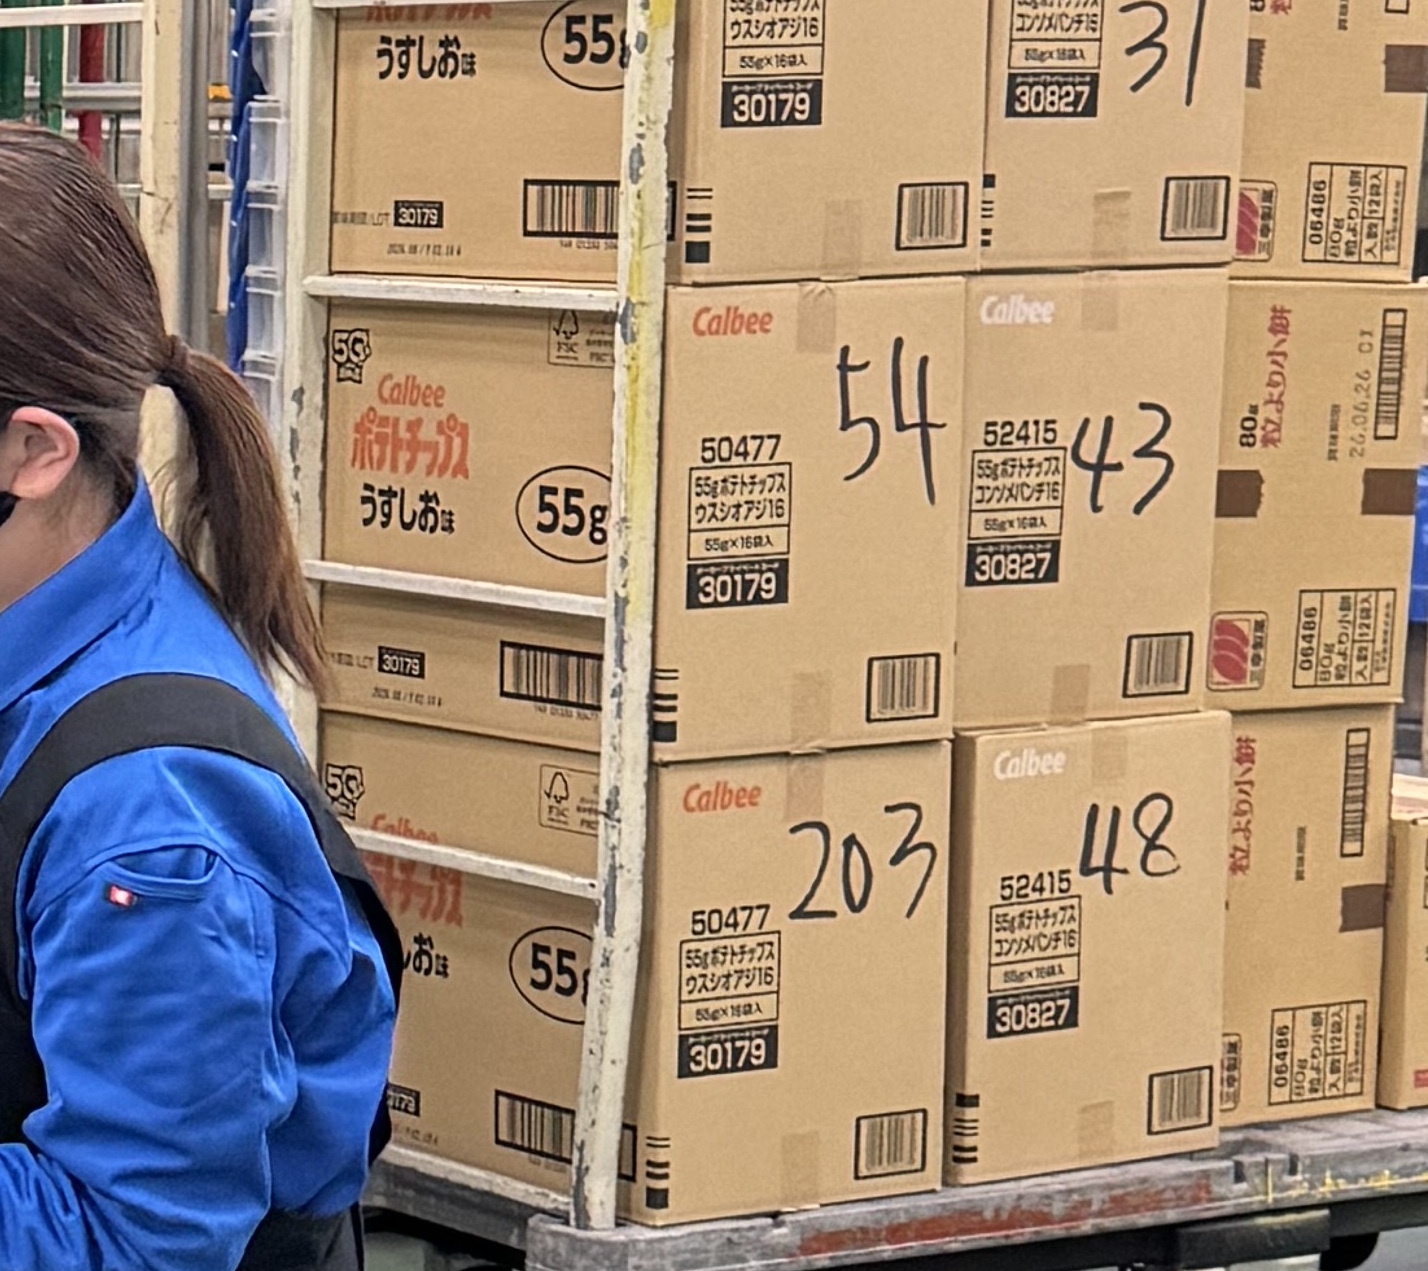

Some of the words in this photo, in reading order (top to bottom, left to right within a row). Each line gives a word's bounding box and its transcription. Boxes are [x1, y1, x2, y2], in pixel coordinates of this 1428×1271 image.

[730, 18, 819, 41] ウスシオアジ16
[376, 34, 477, 80] うすしお味
[732, 93, 811, 123] 30179
[1015, 84, 1091, 115] 30827
[398, 206, 439, 226] 30179
[1309, 178, 1328, 246] 06486
[693, 306, 773, 337] Calbee
[979, 294, 1055, 325] Calbee
[377, 373, 446, 408] Calbee
[836, 336, 947, 506] 54
[983, 419, 1058, 447] 52415
[1239, 403, 1259, 448] 80g
[351, 405, 469, 480] ポテトチップス
[701, 434, 781, 464] 50477
[1071, 401, 1175, 516] 43
[694, 472, 786, 499] 55gポテトチップス
[976, 456, 1061, 482] 55gポテトチップス
[360, 482, 455, 535] うすしお味
[975, 481, 1060, 505] コンソメパンチ16
[536, 484, 608, 545] 55g
[695, 498, 785, 524] ウスシオアジ16
[974, 552, 1051, 582] 30827
[698, 571, 777, 604] 30179
[1299, 605, 1318, 672] 06486
[381, 654, 421, 676] 30179
[995, 748, 1066, 781] Calbee
[683, 780, 762, 813] Calbee
[1079, 792, 1182, 896] 48
[788, 802, 938, 920] 203
[1000, 869, 1071, 901] 52415
[691, 903, 771, 936] 50477
[685, 941, 775, 970] 55gポテトチップス
[994, 929, 1077, 958] コンソメパンチ16
[685, 965, 774, 995] ウスシオアジ16
[995, 999, 1071, 1033] 30827
[689, 1039, 766, 1072] 30179
[1272, 1023, 1289, 1089] 06486
